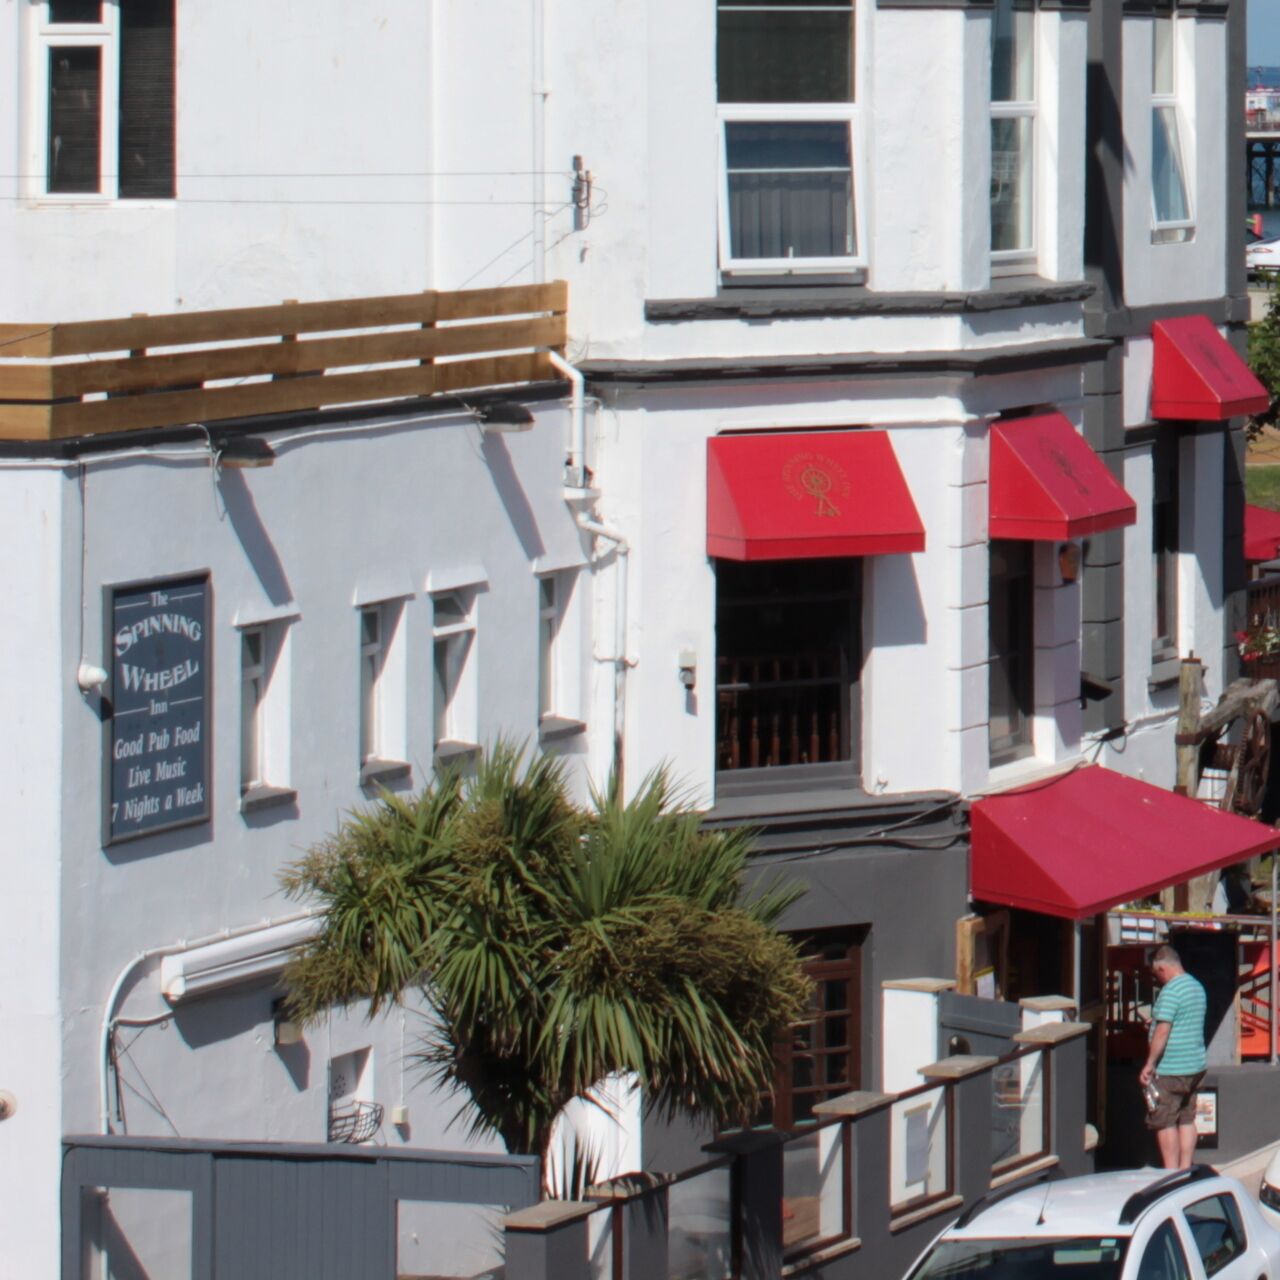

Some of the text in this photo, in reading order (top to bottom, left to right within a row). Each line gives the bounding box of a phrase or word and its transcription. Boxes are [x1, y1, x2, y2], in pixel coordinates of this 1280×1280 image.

[150, 590, 168, 607] The
[115, 613, 202, 657] SPINNING
[122, 659, 200, 693] WHEEL
[150, 699, 168, 716] Inn
[114, 721, 200, 760] Good Pub Food
[128, 756, 187, 788] Live Music
[112, 782, 204, 823] 7 Nights a Week
